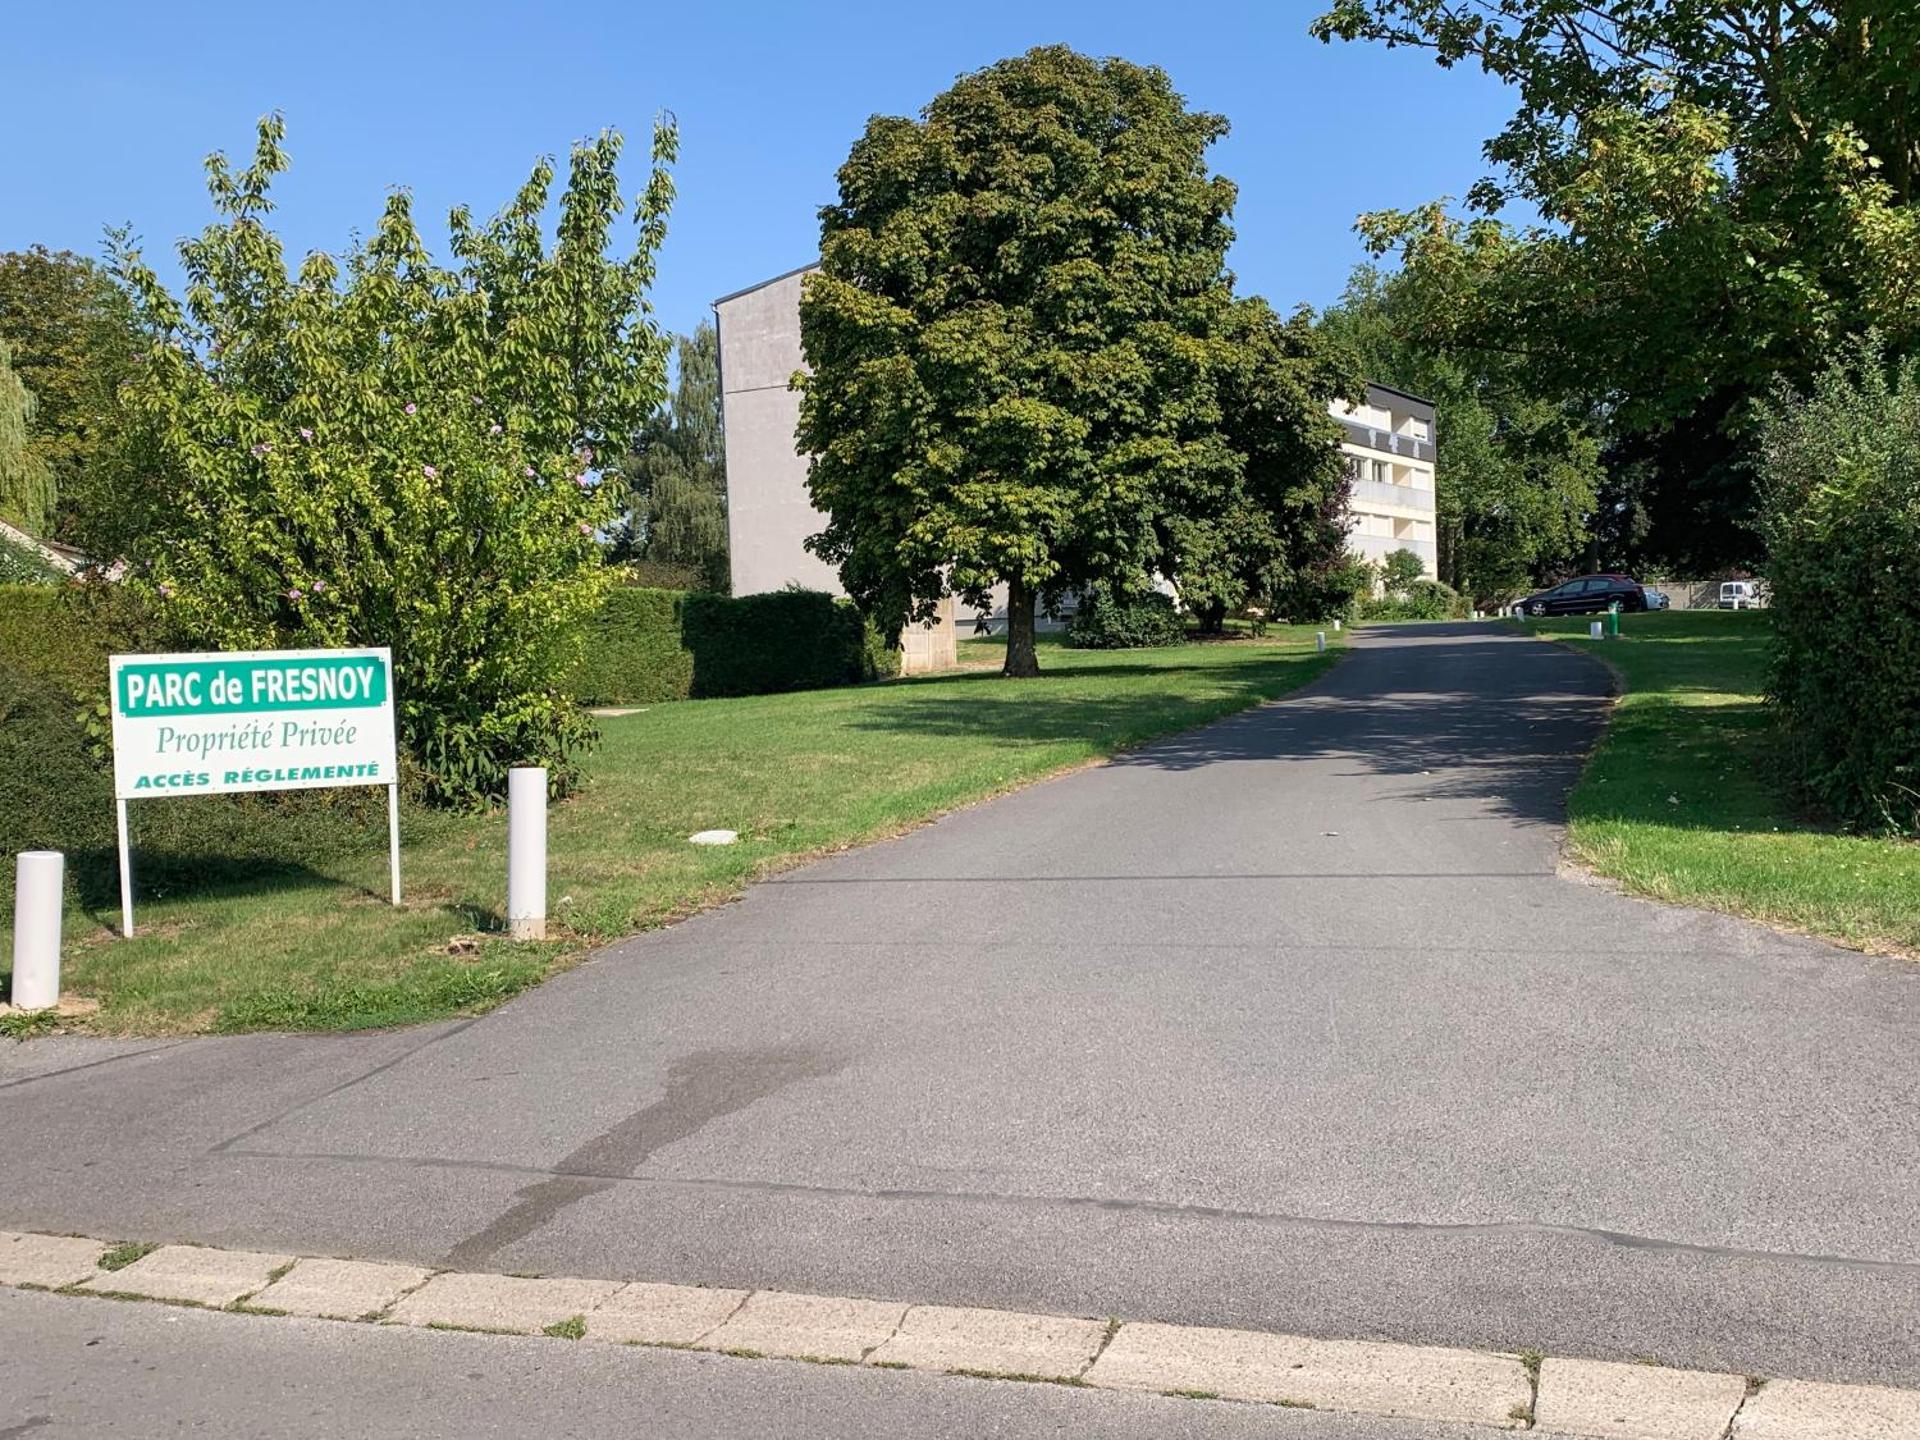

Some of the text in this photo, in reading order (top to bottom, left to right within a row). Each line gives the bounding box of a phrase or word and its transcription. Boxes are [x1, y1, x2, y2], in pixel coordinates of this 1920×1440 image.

[127, 666, 374, 709] PARC de FRESNOY
[156, 719, 357, 760] Propriété Privée
[134, 761, 379, 789] ACCÈS RÉGLEMENTÉ
